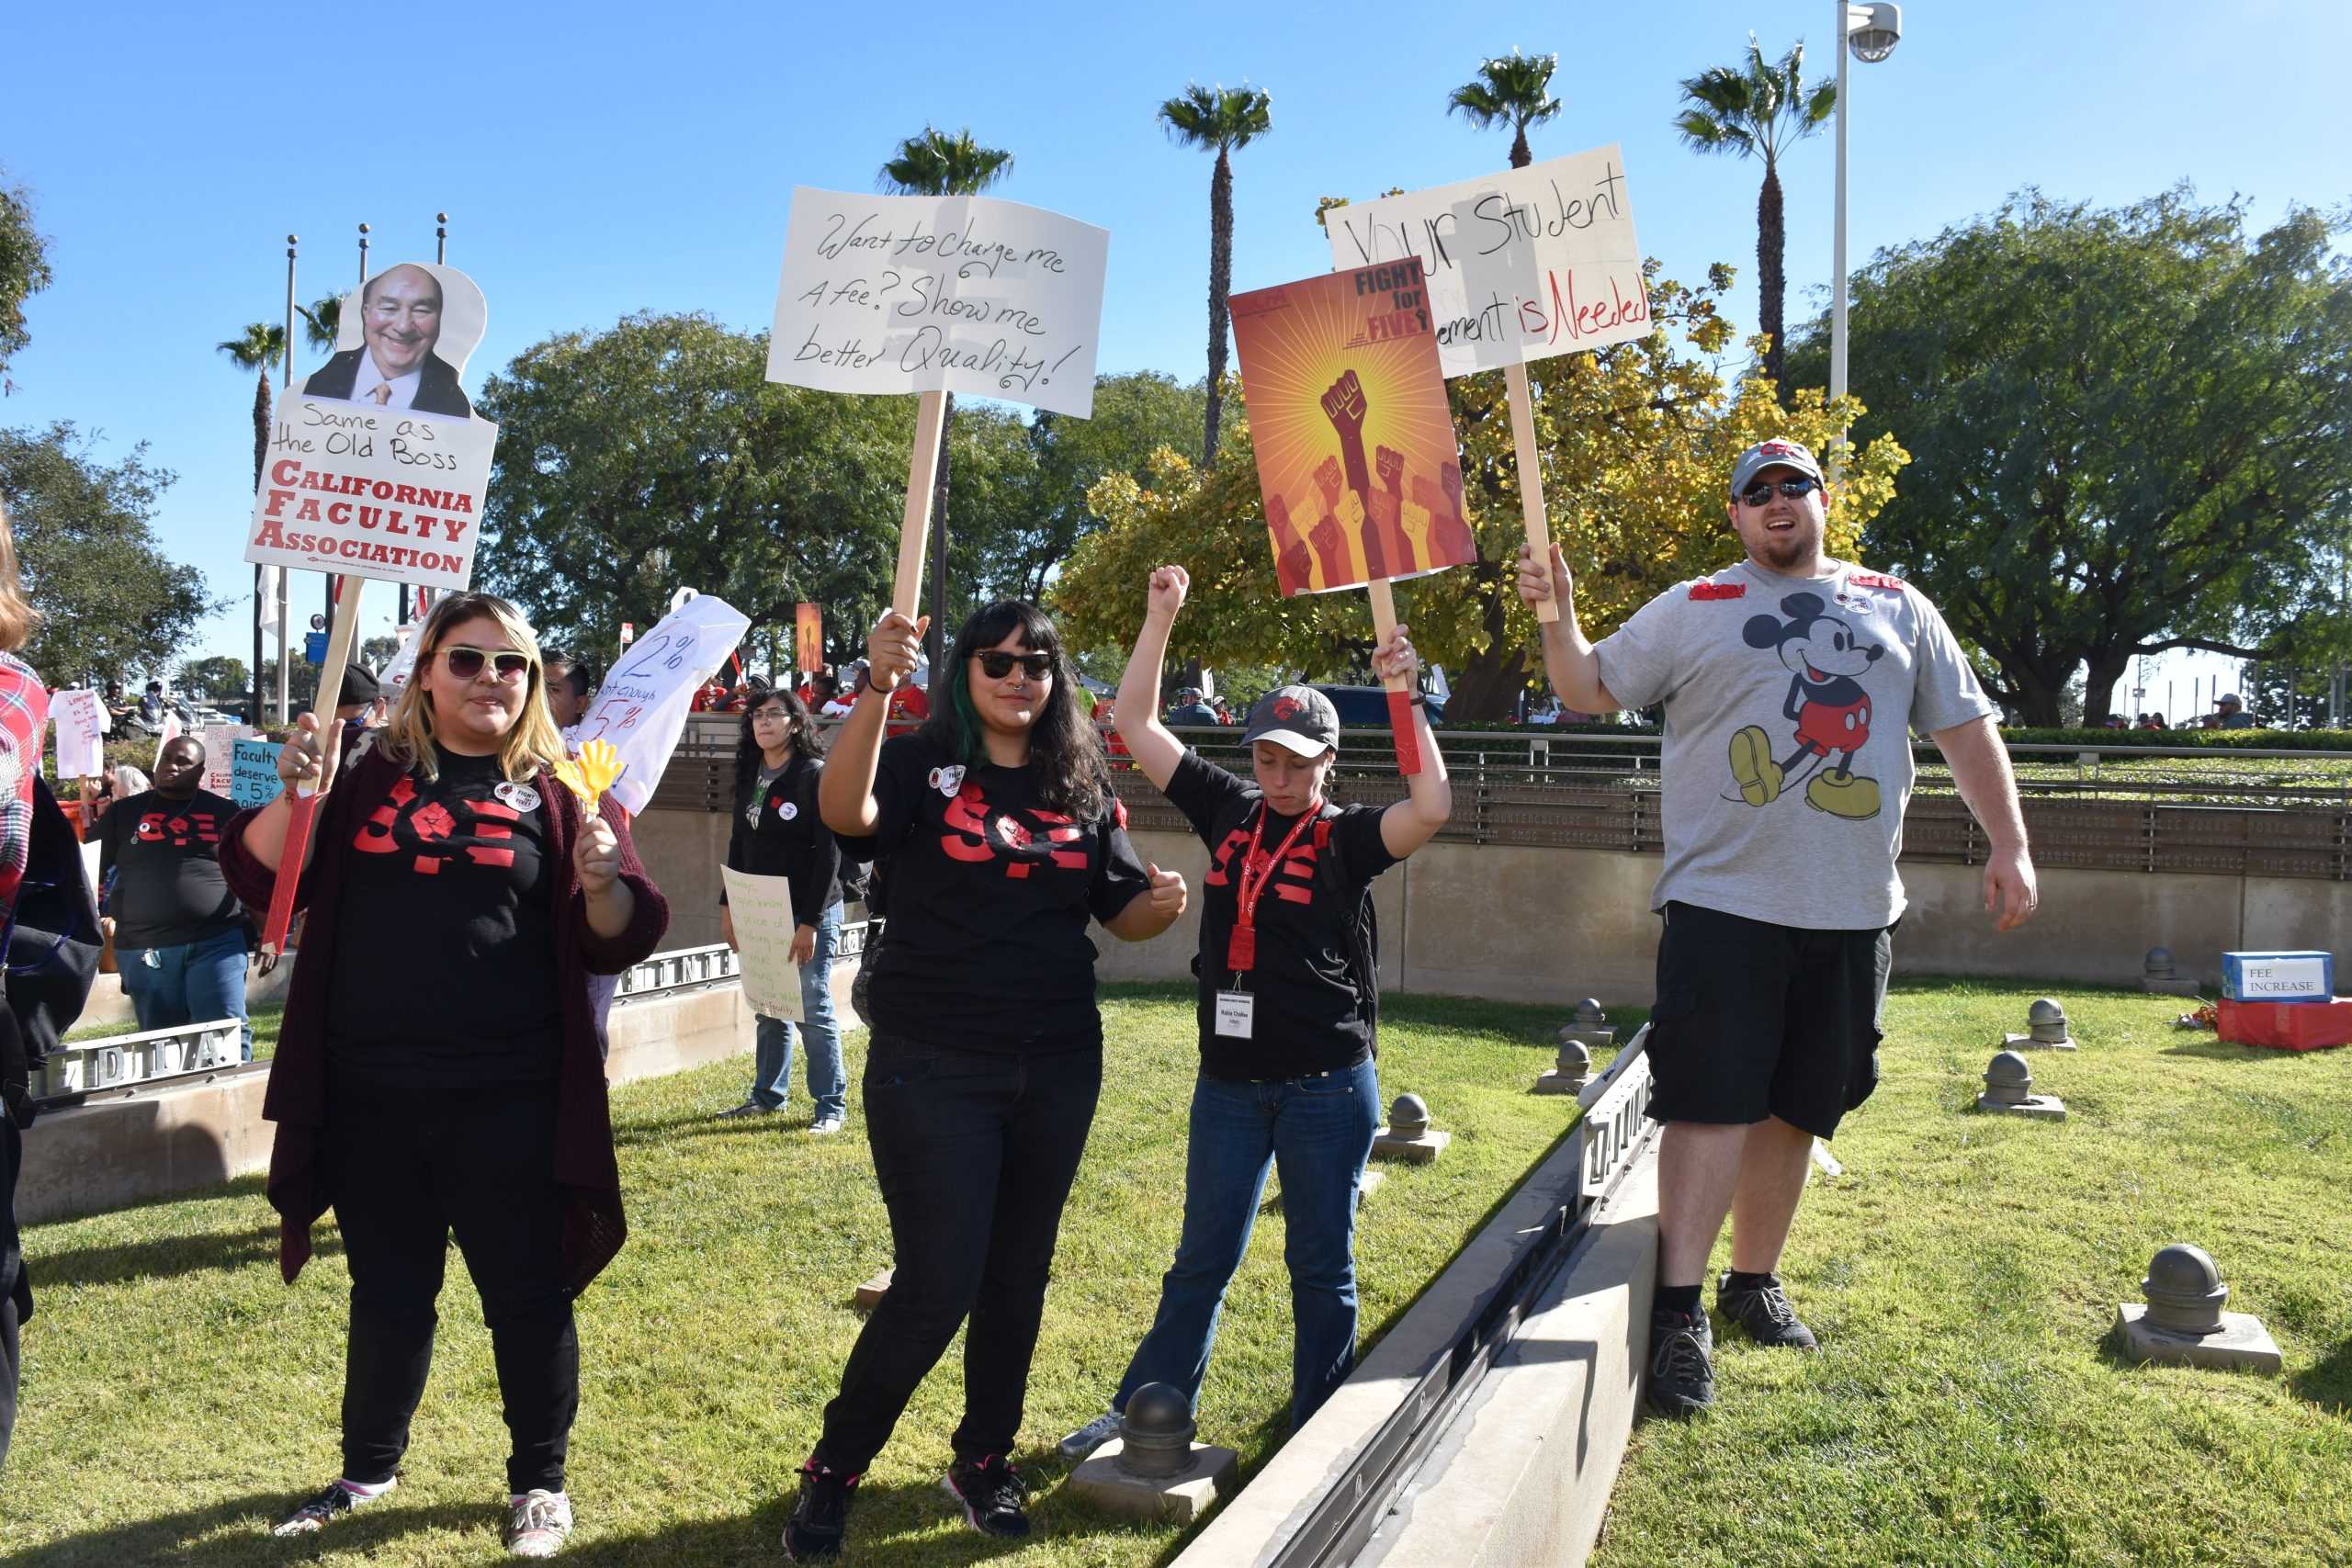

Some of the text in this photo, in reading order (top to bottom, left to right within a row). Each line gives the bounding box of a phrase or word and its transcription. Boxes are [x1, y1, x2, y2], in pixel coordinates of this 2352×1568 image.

[1474, 162, 1624, 254] Student
[817, 213, 893, 260] Want
[895, 220, 936, 256] to
[1024, 249, 1066, 274] me
[1354, 261, 1420, 297] FIGHT
[1393, 289, 1421, 310] for
[898, 275, 990, 321] Show
[995, 310, 1046, 335] me
[1515, 296, 1549, 333] is
[1549, 269, 1646, 345] Needed
[793, 322, 1081, 391] better Quality!
[272, 422, 457, 470] the Old Boss
[303, 404, 435, 441] Same as
[271, 459, 473, 513] CALIFORNIA
[265, 490, 468, 543] FACULTY
[254, 520, 464, 574] ASSOCIATION
[234, 743, 278, 770] Faculty
[234, 766, 278, 784] deserve
[250, 783, 275, 800] 5%
[2250, 968, 2272, 978] FEE
[2250, 981, 2315, 992] INCREASE
